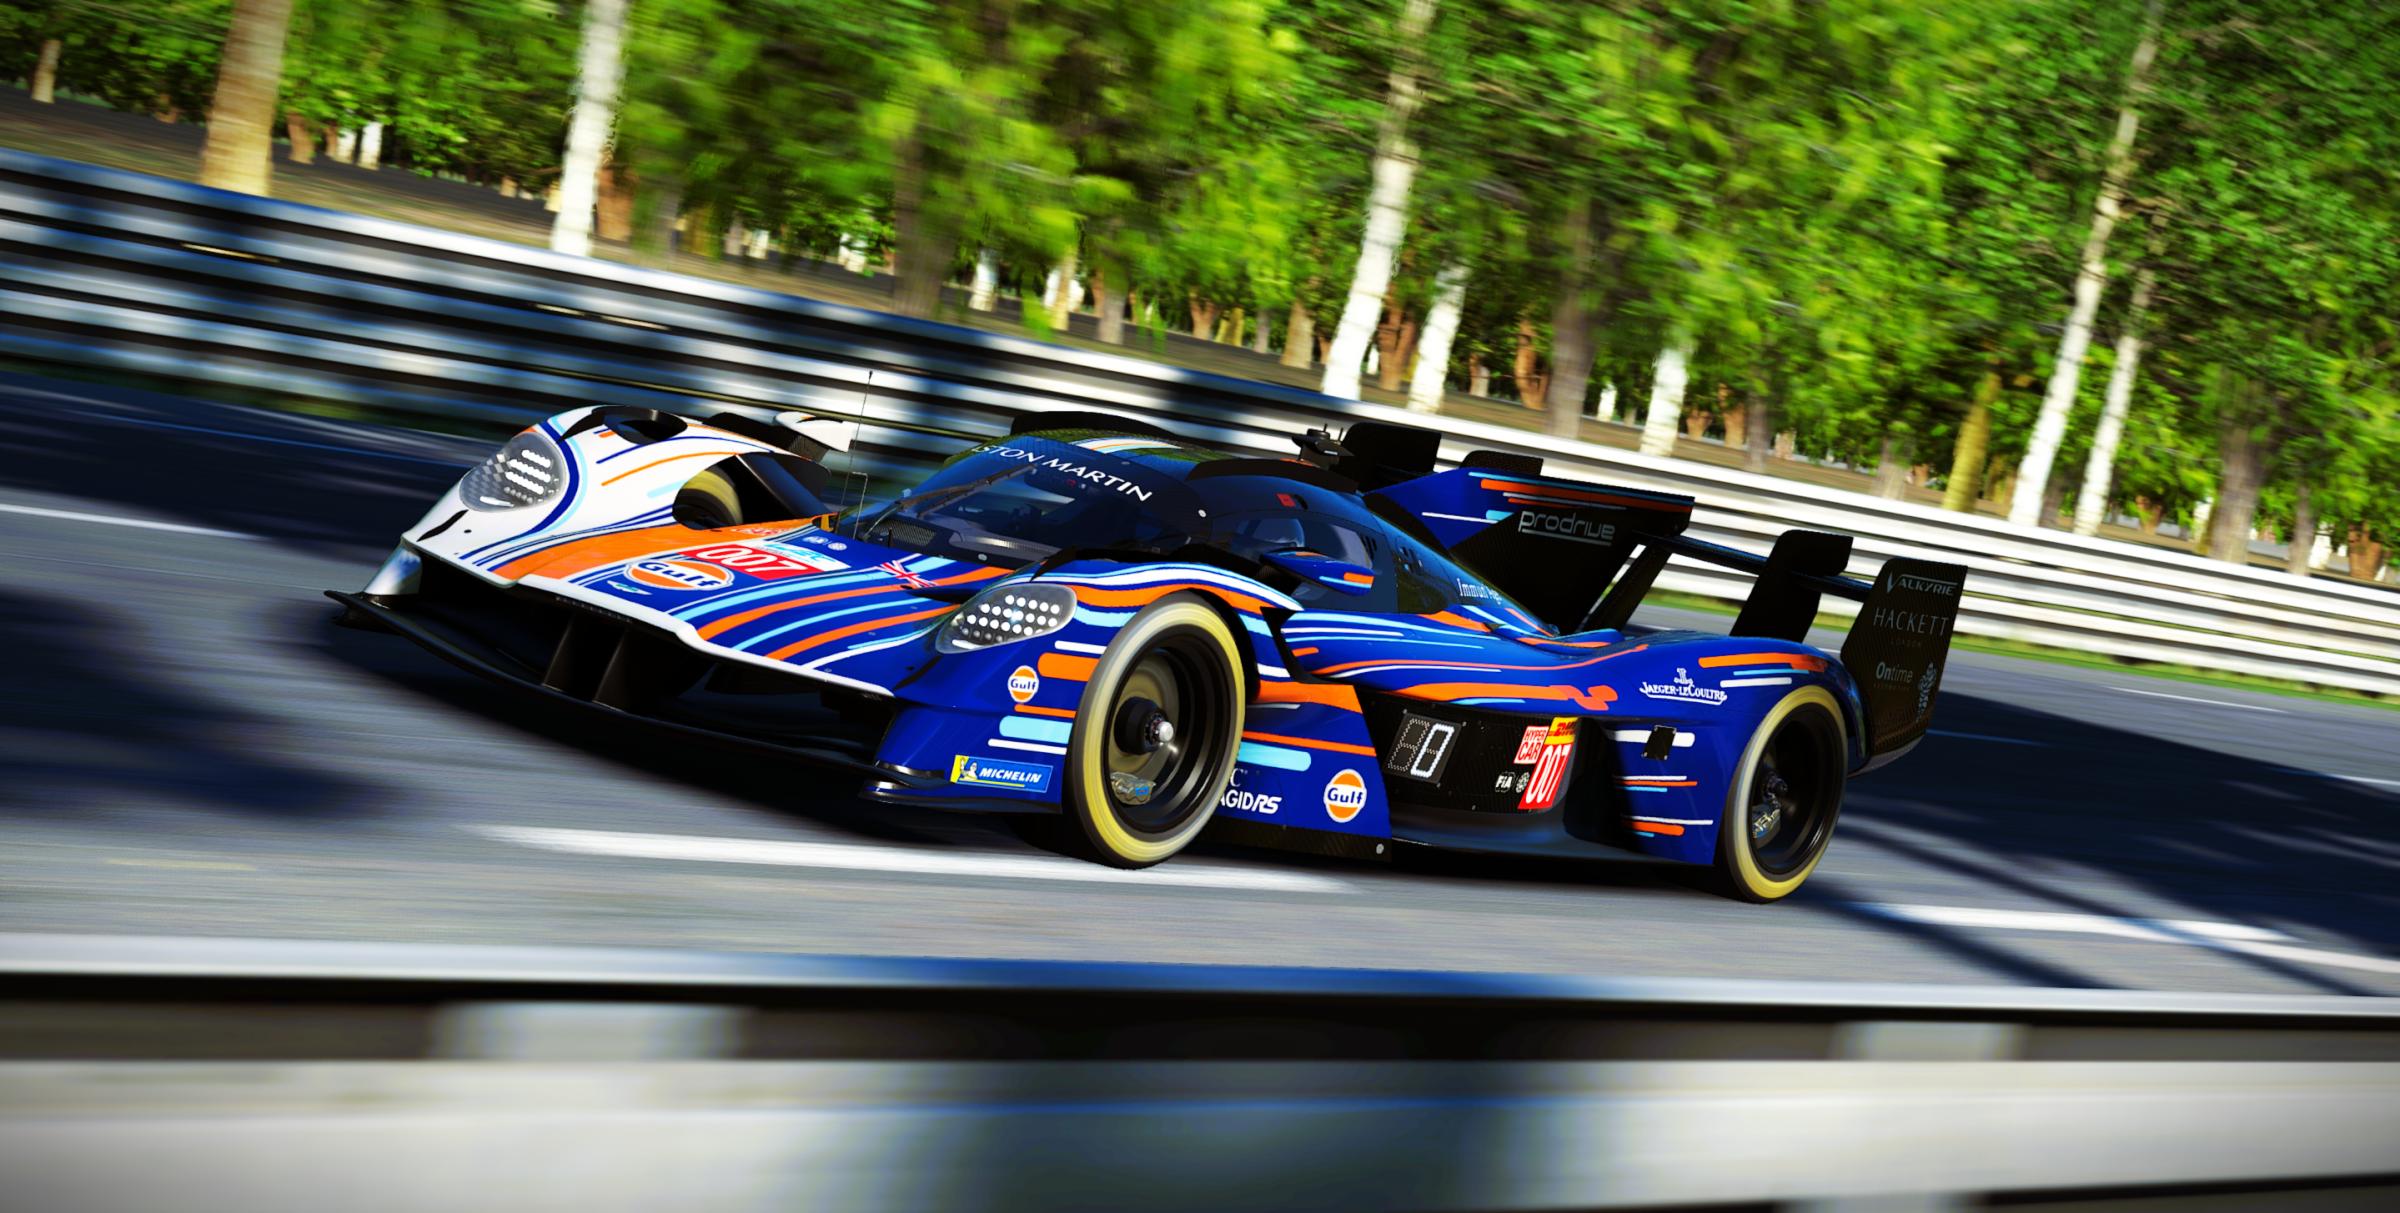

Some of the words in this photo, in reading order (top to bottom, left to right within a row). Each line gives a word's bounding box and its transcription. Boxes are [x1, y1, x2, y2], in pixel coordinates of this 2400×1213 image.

[971, 444, 1045, 462] STON
[1042, 458, 1152, 502] MARTIN
[1518, 511, 1615, 540] prodrive
[696, 547, 808, 572] 007
[638, 561, 721, 587] Gulf
[1886, 571, 1958, 597] VALKYRIE
[1873, 607, 1949, 636] HACKETT
[1010, 678, 1037, 691] Gulf
[1875, 661, 1913, 684] Ontime
[1523, 729, 1547, 741] HYPER
[1518, 742, 1542, 760] CAR
[979, 767, 1042, 783] MICHELIN
[1495, 775, 1513, 788] FIA
[1525, 744, 1572, 803] 007
[1327, 787, 1363, 804] Gulf
